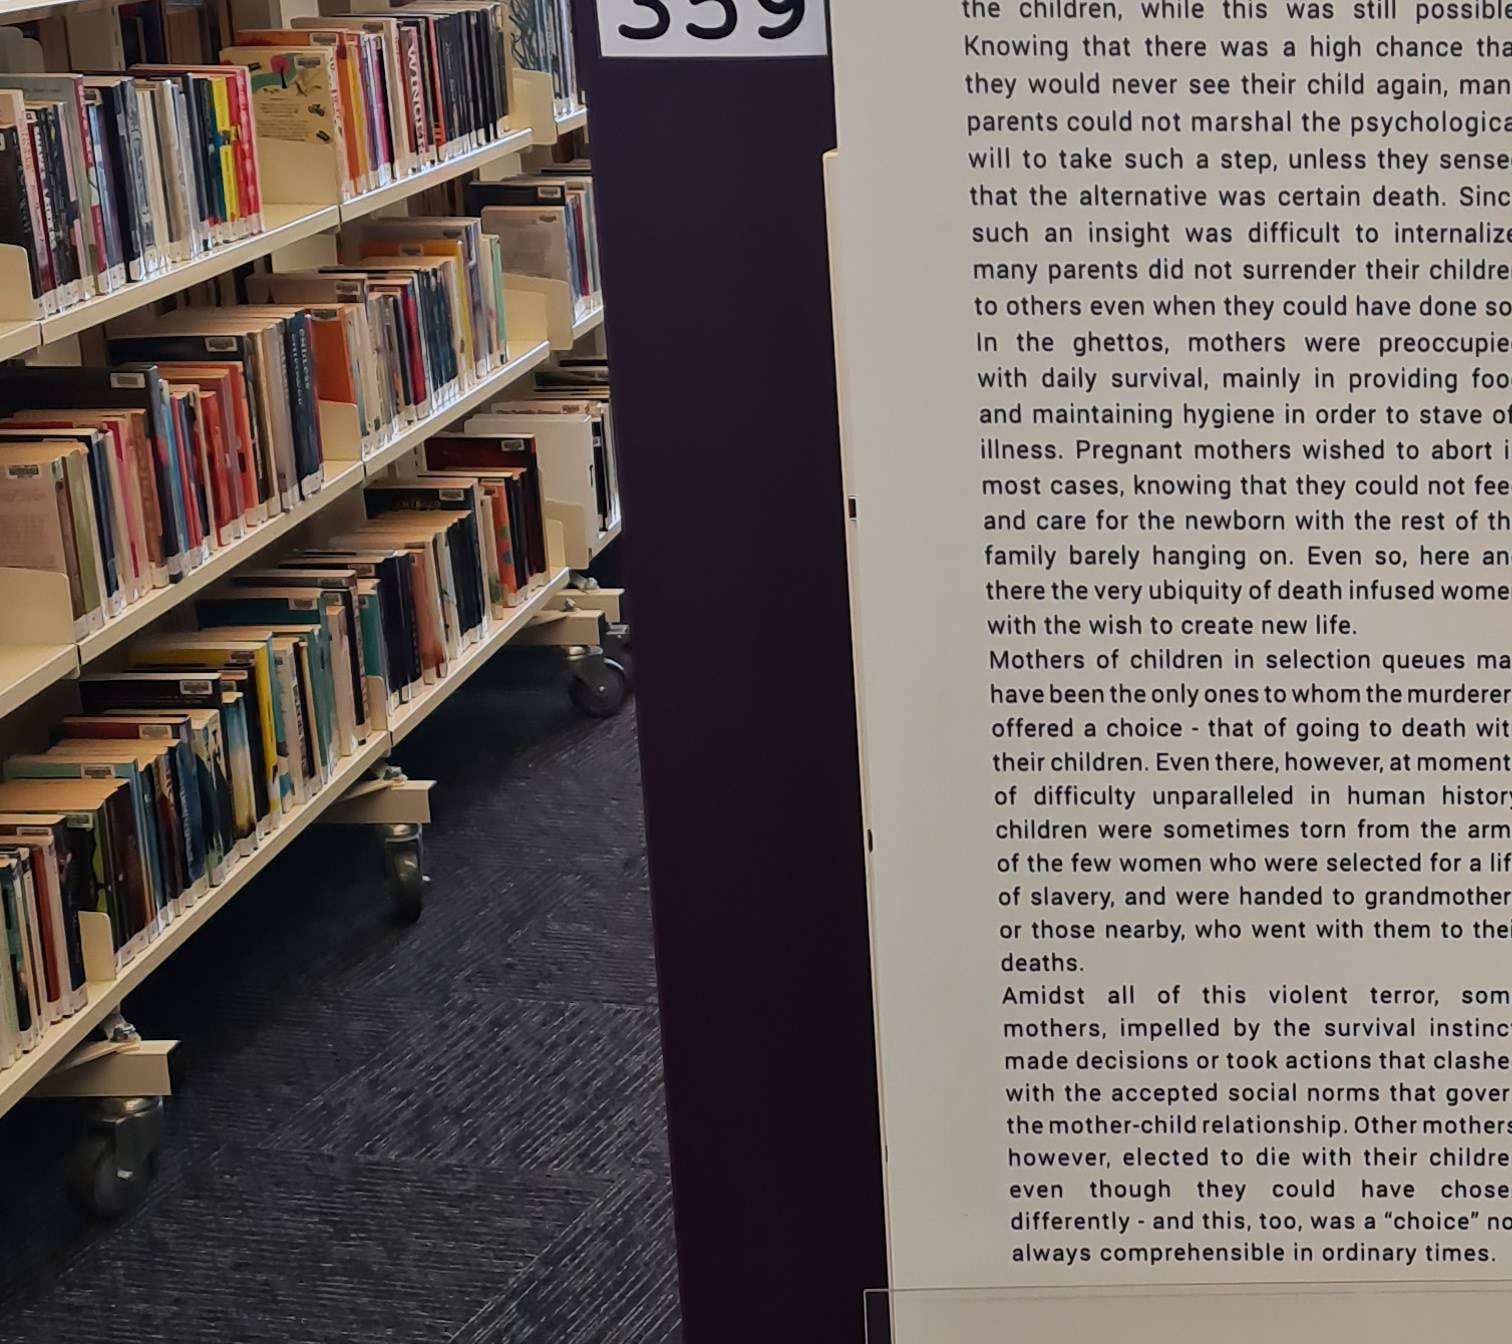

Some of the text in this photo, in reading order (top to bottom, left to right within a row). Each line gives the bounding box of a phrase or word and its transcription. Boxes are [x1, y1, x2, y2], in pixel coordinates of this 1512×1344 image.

[964, 33, 1069, 62] Knowing
[1082, 34, 1131, 57] that
[1144, 34, 1207, 57] there
[1220, 40, 1269, 57] was
[1282, 40, 1296, 58] a
[1310, 34, 1362, 63] high
[1375, 34, 1463, 58] chance
[969, 183, 1018, 207] that
[1028, 183, 1068, 207] the
[1079, 183, 1208, 207] alternative
[1218, 189, 1266, 207] was
[1278, 184, 1361, 207] certain
[1372, 184, 1446, 207] death.
[977, 366, 1027, 389] with
[1041, 366, 1097, 393] daily
[1111, 366, 1209, 392] survival,
[1222, 366, 1301, 394] mainly
[1314, 366, 1335, 389] in
[1349, 366, 1458, 394] providing
[985, 579, 1046, 601] there
[1050, 579, 1089, 601] the
[1093, 584, 1143, 606] very
[1148, 578, 1243, 605] ubiquity
[1248, 578, 1273, 601] of
[1277, 579, 1342, 601] death
[1349, 578, 1435, 601] infused
[999, 924, 1023, 940] or
[1031, 919, 1096, 940] those
[1105, 918, 1186, 944] nearby,
[1194, 918, 1242, 939] who
[1251, 920, 1307, 939] went
[1315, 918, 1364, 939] with
[1373, 918, 1431, 939] them
[1440, 921, 1464, 939] to
[1003, 1017, 1107, 1040] mothers,
[1120, 1017, 1220, 1042] impelled
[1233, 1017, 1261, 1042] by
[1273, 1017, 1311, 1037] the
[1324, 1016, 1415, 1037] survival
[1012, 1241, 1496, 1267] always comprehensible in ordinary times.
